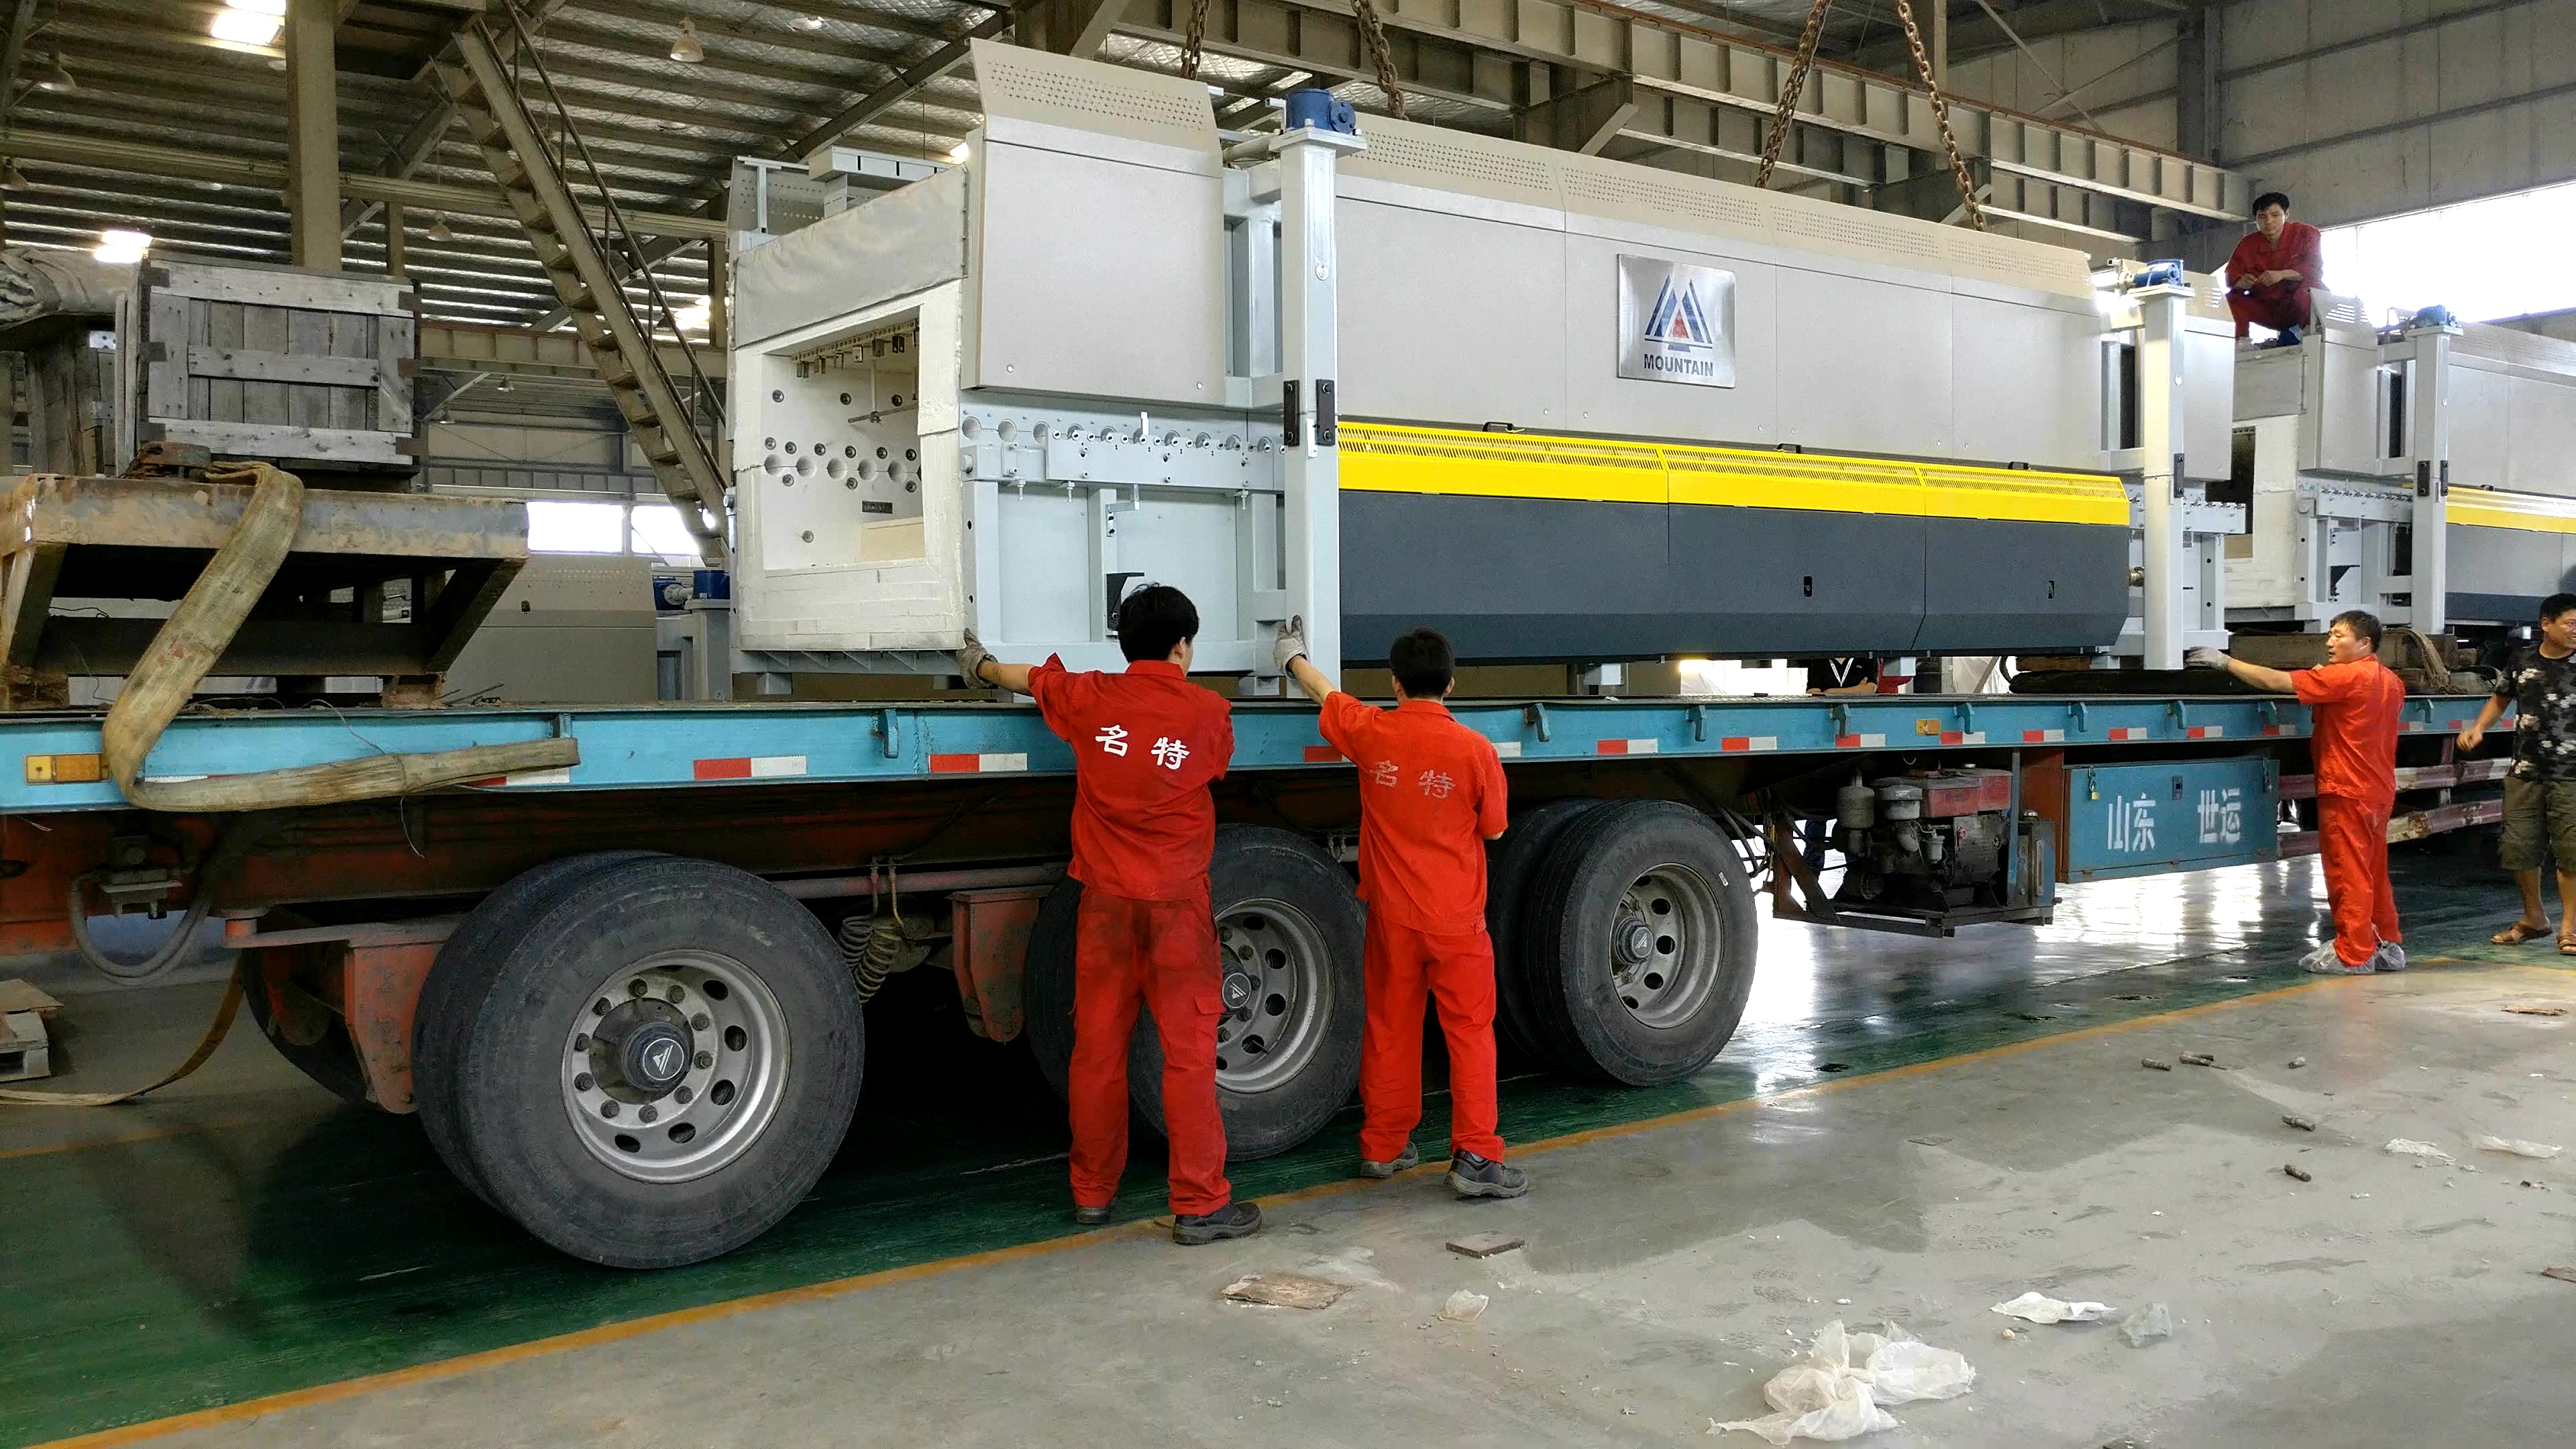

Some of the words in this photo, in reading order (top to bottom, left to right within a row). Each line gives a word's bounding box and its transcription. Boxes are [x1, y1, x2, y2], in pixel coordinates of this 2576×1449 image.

[1644, 354, 1713, 377] MOUNTAIN
[1095, 724, 1191, 770] 名特
[1368, 759, 1456, 799] 名特
[2107, 792, 2157, 853] 山东
[2197, 788, 2241, 844] 世运
